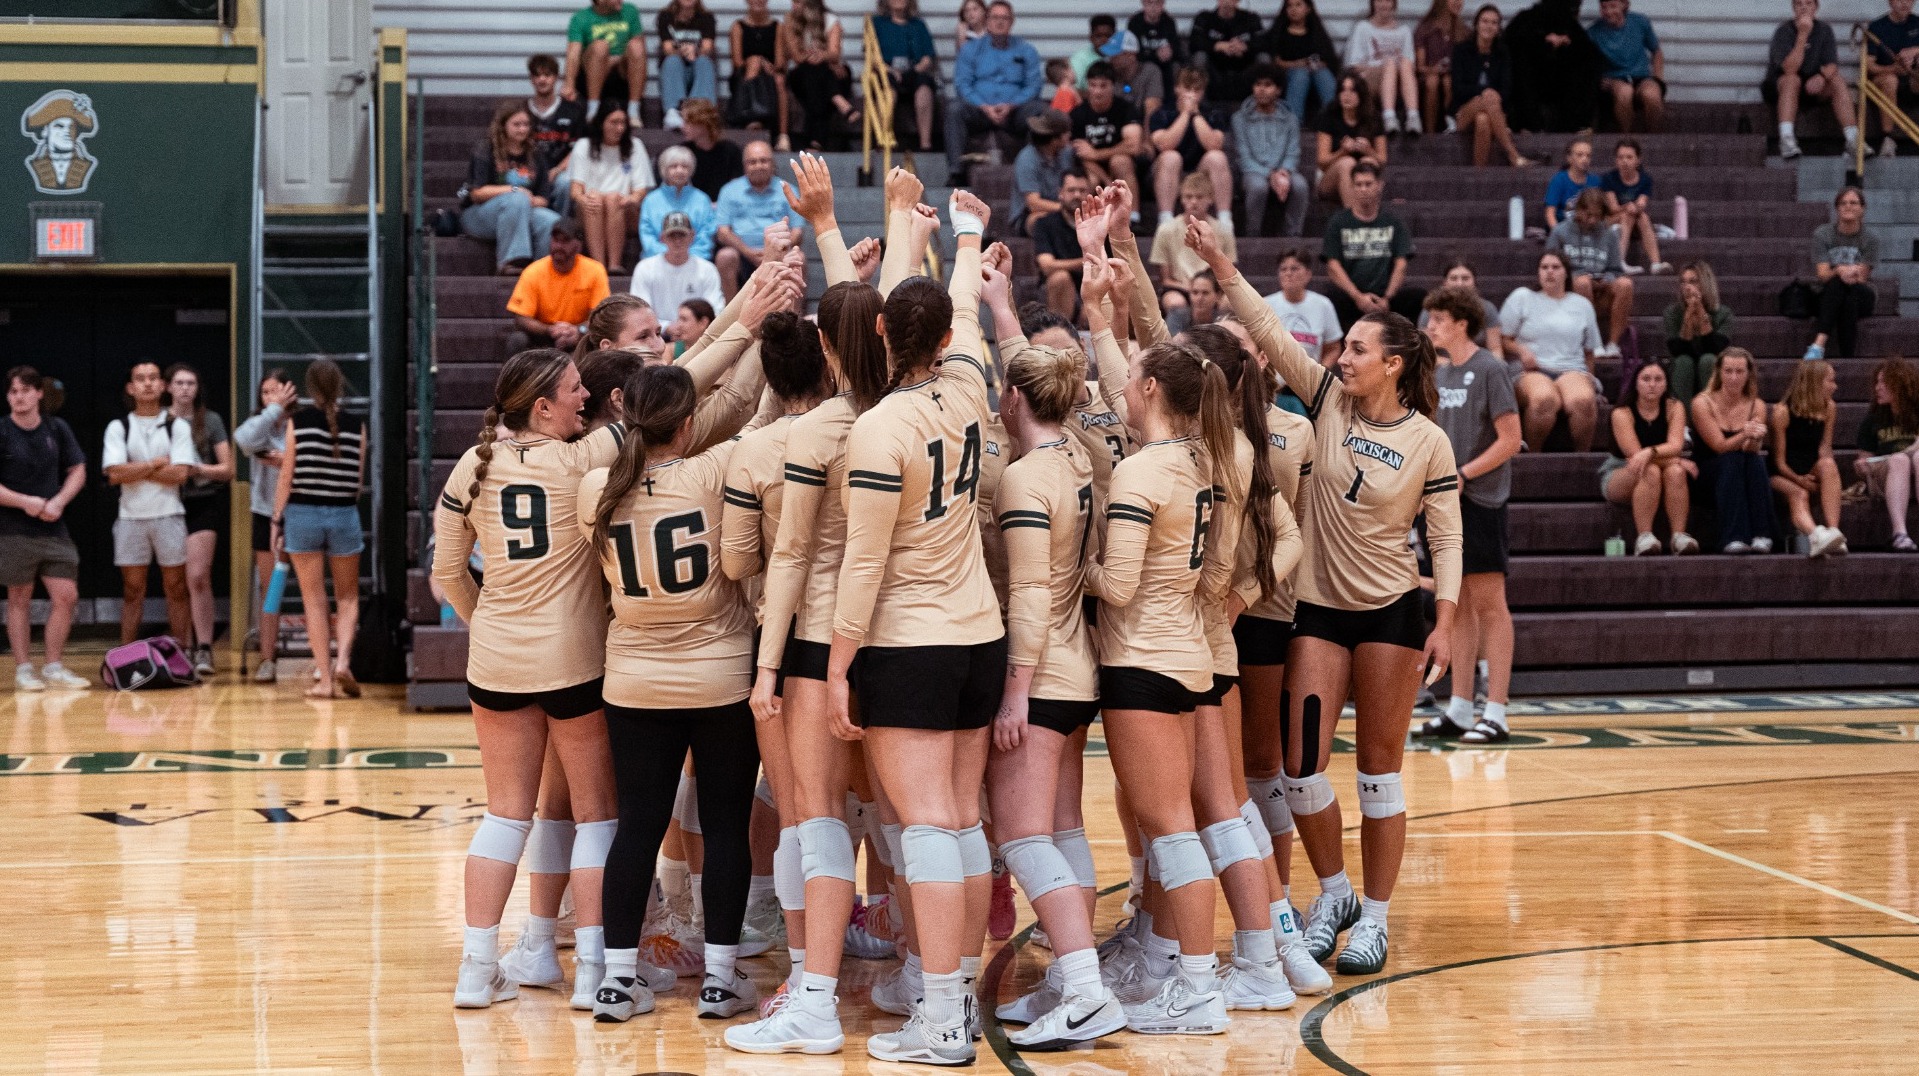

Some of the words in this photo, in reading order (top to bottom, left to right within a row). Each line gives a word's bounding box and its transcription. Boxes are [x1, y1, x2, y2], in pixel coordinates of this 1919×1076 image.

[47, 221, 85, 251] EXIT
[925, 418, 981, 523] 14
[1104, 434, 1125, 472] 3
[1344, 465, 1365, 505] 1
[499, 482, 550, 563] 9
[608, 508, 712, 599] 16
[1077, 481, 1093, 571] 7
